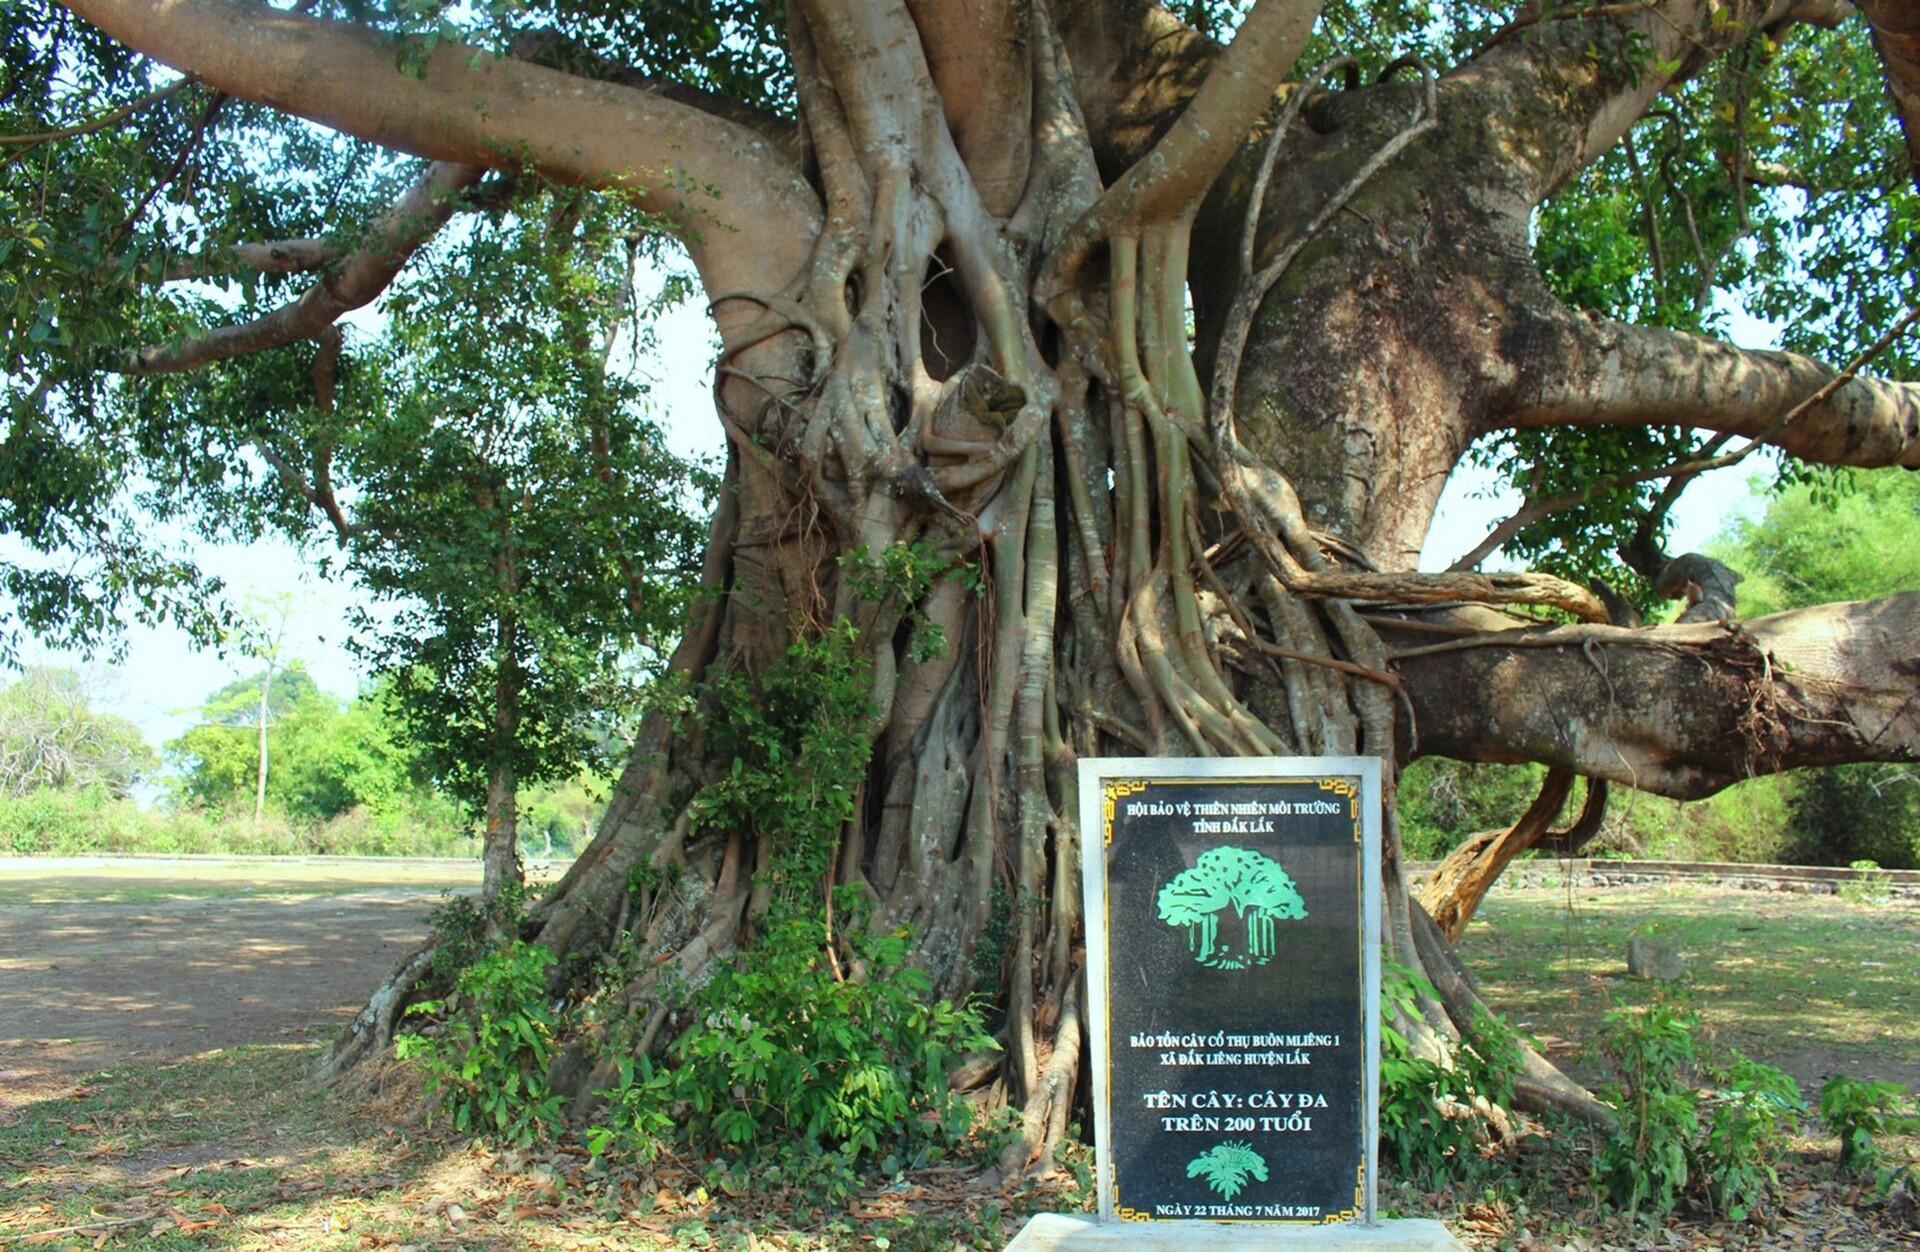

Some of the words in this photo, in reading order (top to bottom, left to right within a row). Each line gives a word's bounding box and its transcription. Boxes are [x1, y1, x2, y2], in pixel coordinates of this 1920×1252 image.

[1127, 801, 1148, 817] HỘI
[1150, 800, 1174, 815] BẢO
[1175, 800, 1191, 818] VỆ
[1193, 801, 1228, 815] THIÊN
[1230, 801, 1267, 815] NHIÊN
[1269, 800, 1292, 815] MÔI
[1293, 800, 1340, 815] TRƯỜNG
[1193, 817, 1221, 833] TỈNH
[1223, 816, 1248, 833] ĐẮK
[1250, 816, 1274, 833] LẮK
[1130, 1032, 1154, 1047] BẢO
[1181, 1033, 1206, 1047] CÂY
[1208, 1030, 1224, 1047] CỔ
[1226, 1035, 1250, 1050] THỤ
[1252, 1033, 1284, 1047] BUÔN
[1286, 1033, 1332, 1047] MLIÊNG
[1334, 1035, 1340, 1047] 1
[1160, 1051, 1176, 1065] XÃ
[1178, 1049, 1205, 1065] ĐẮK
[1206, 1051, 1241, 1065] LIÊNG
[1244, 1051, 1284, 1067] HUYỆN
[1286, 1047, 1311, 1065] LẮK
[1143, 1090, 1187, 1109] TÊN
[1191, 1090, 1243, 1109] CÂY:
[1247, 1090, 1294, 1108] CÂY
[1298, 1093, 1329, 1108] ĐA
[1161, 1113, 1220, 1132] TRÊN
[1224, 1117, 1255, 1132] 200
[1259, 1110, 1312, 1132] TUỔI
[1156, 1203, 1192, 1216] NGÀY
[1194, 1205, 1207, 1216] 22
[1208, 1203, 1253, 1217] THÁNG
[1255, 1206, 1262, 1217] 7
[1264, 1203, 1294, 1217] NĂM
[1296, 1206, 1320, 1218] 2017
